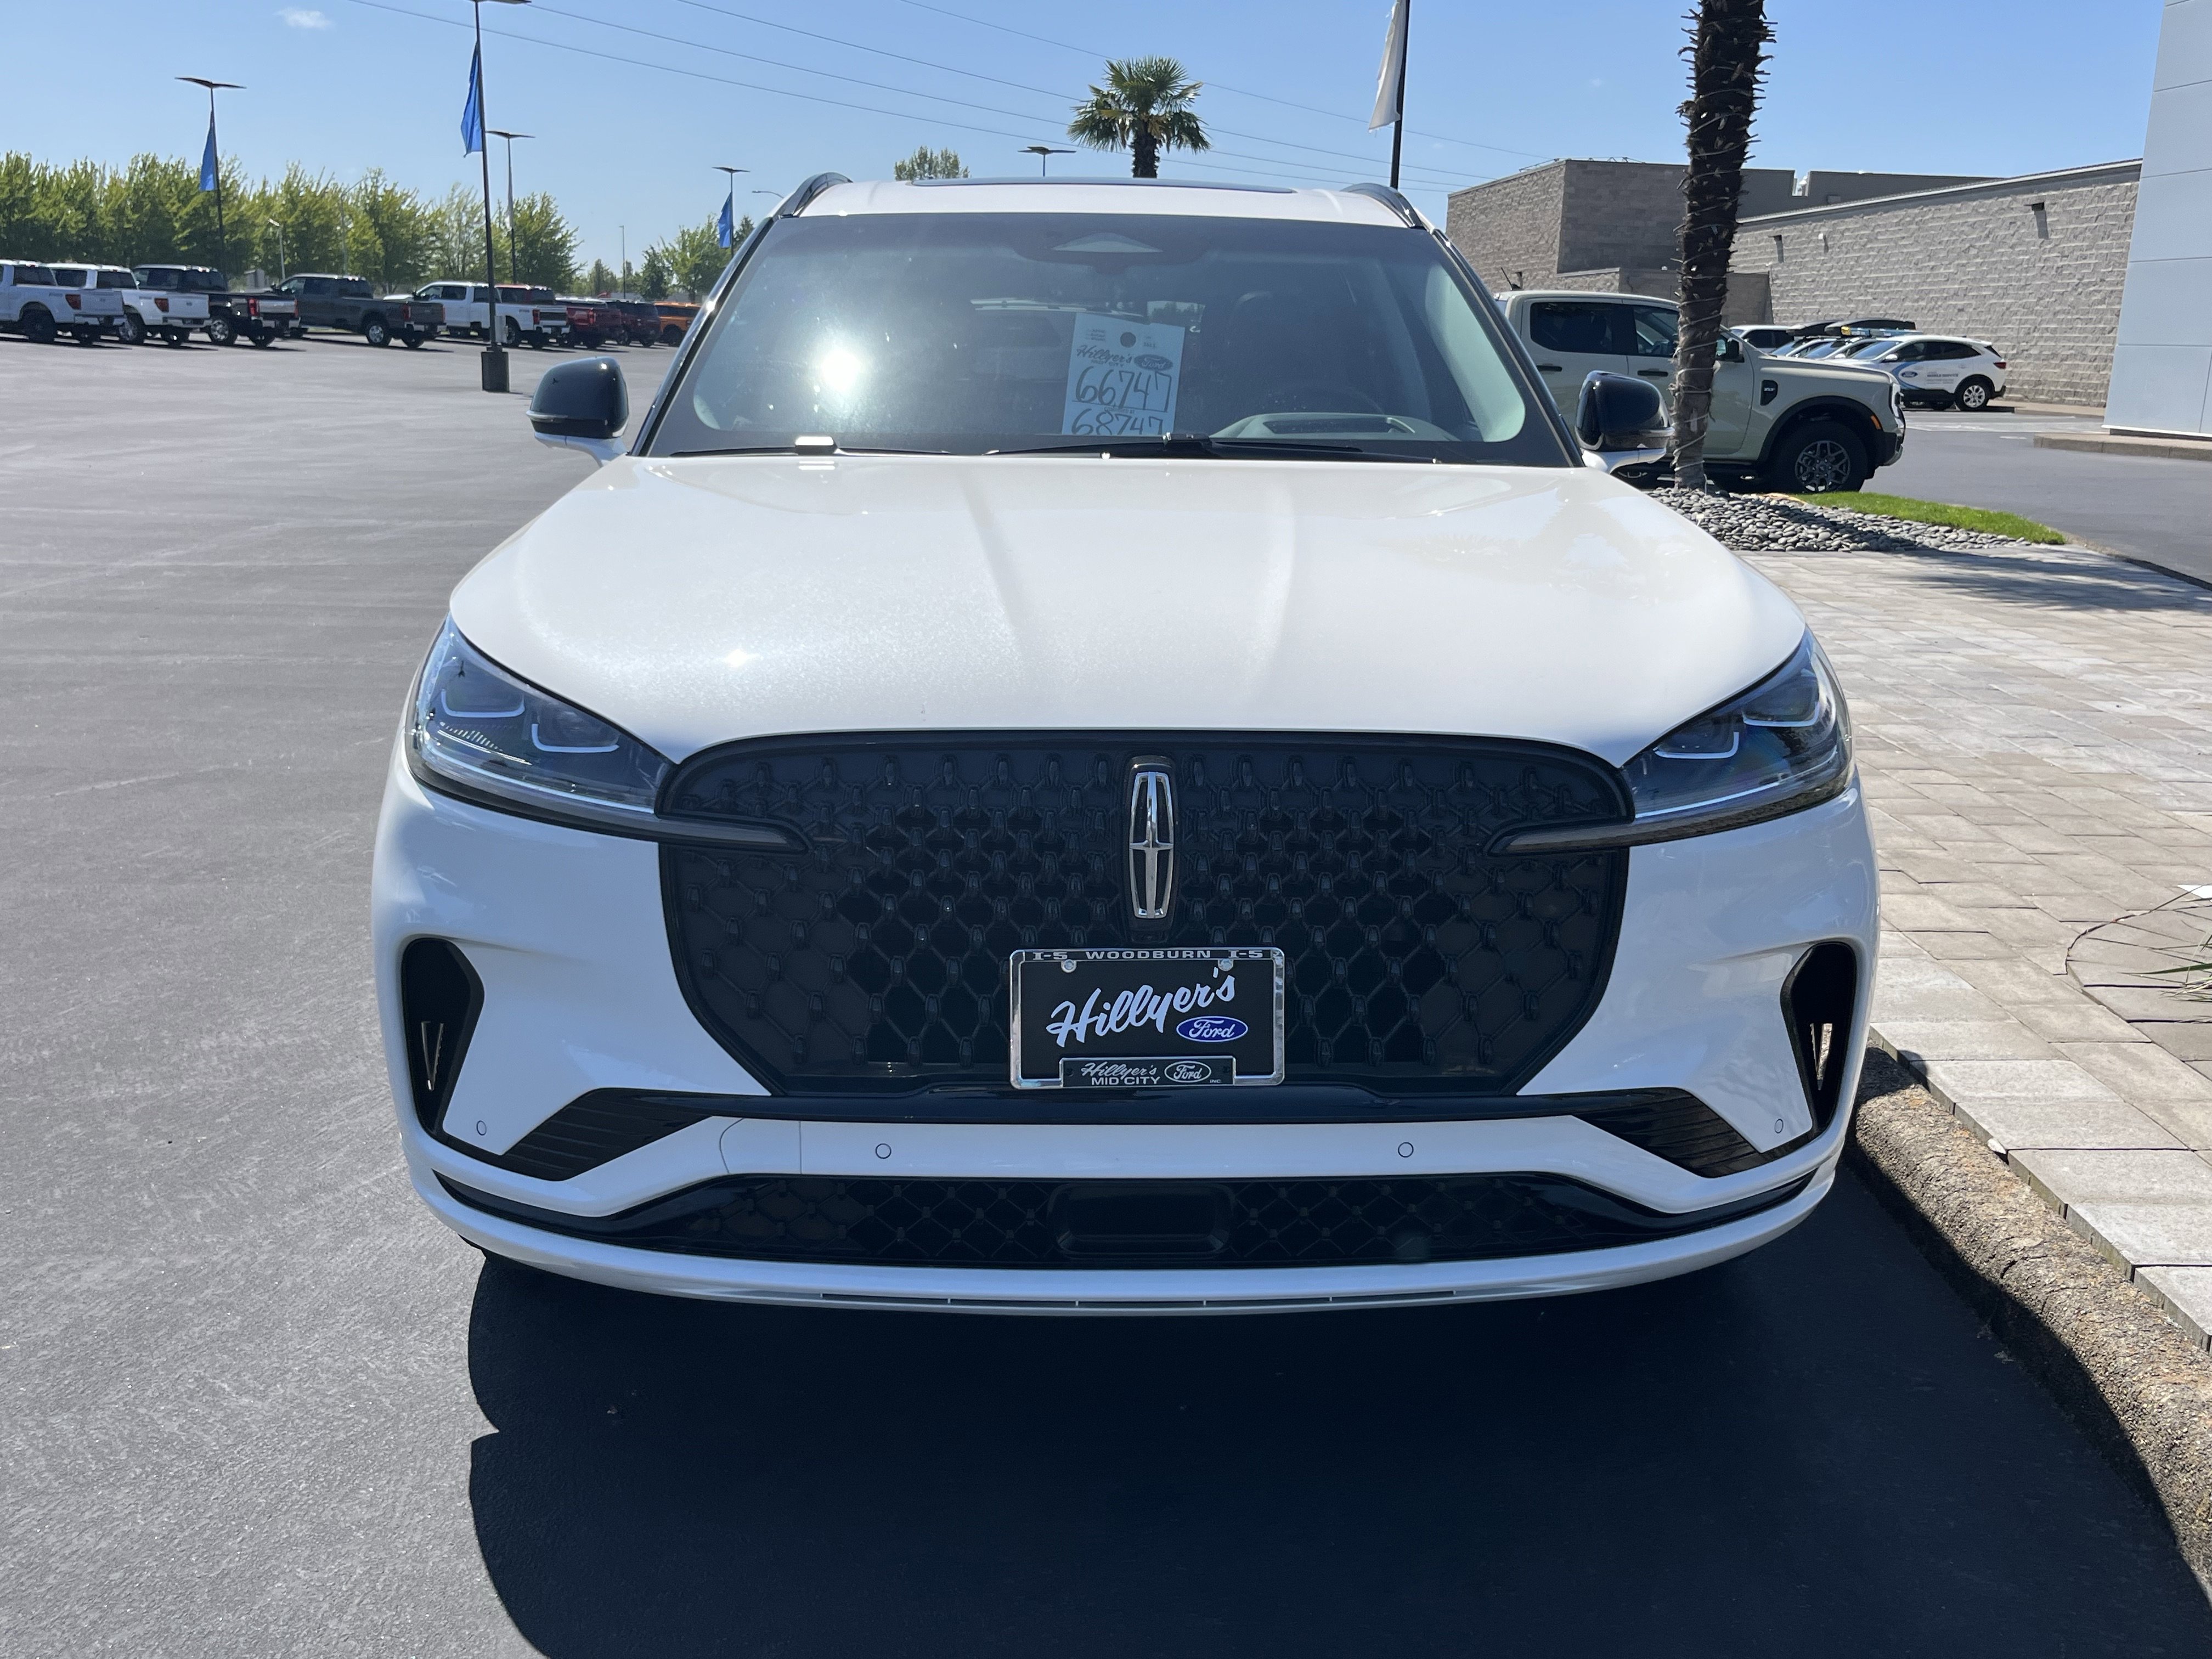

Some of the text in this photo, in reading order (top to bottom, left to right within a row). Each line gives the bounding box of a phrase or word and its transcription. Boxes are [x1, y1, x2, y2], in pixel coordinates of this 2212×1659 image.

[1032, 950, 1263, 960] I-5 WOODBURN I-5
[1046, 967, 1235, 1048] Hillyer's
[1188, 1017, 1235, 1039] Ford
[1081, 1062, 1157, 1080] Hillyer's
[1173, 1064, 1203, 1080] Ford
[1124, 1076, 1160, 1085] CITY
